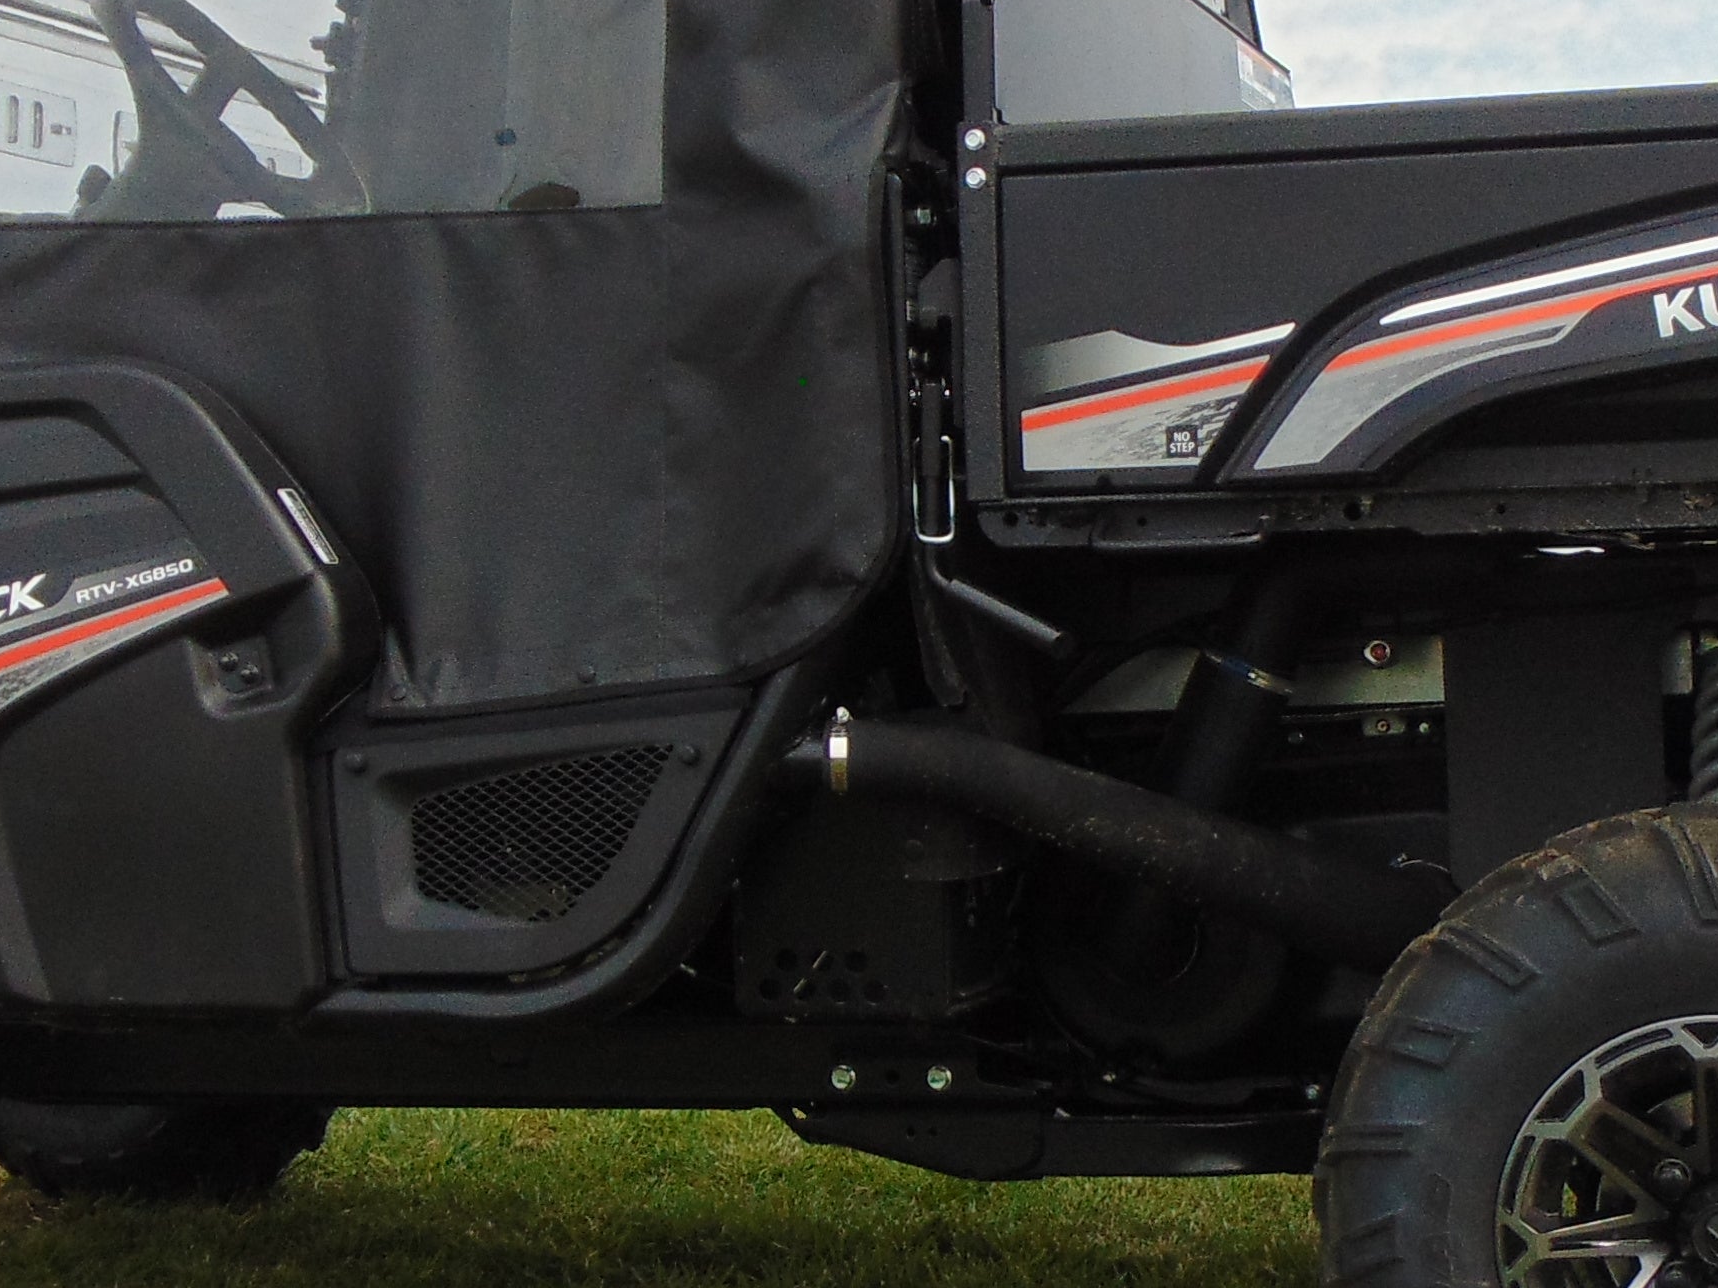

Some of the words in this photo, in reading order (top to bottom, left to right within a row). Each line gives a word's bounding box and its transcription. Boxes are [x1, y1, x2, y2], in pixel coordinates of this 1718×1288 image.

[1173, 431, 1191, 442] NO
[1169, 441, 1196, 453] STEP
[75, 558, 194, 605] RTV-XG850
